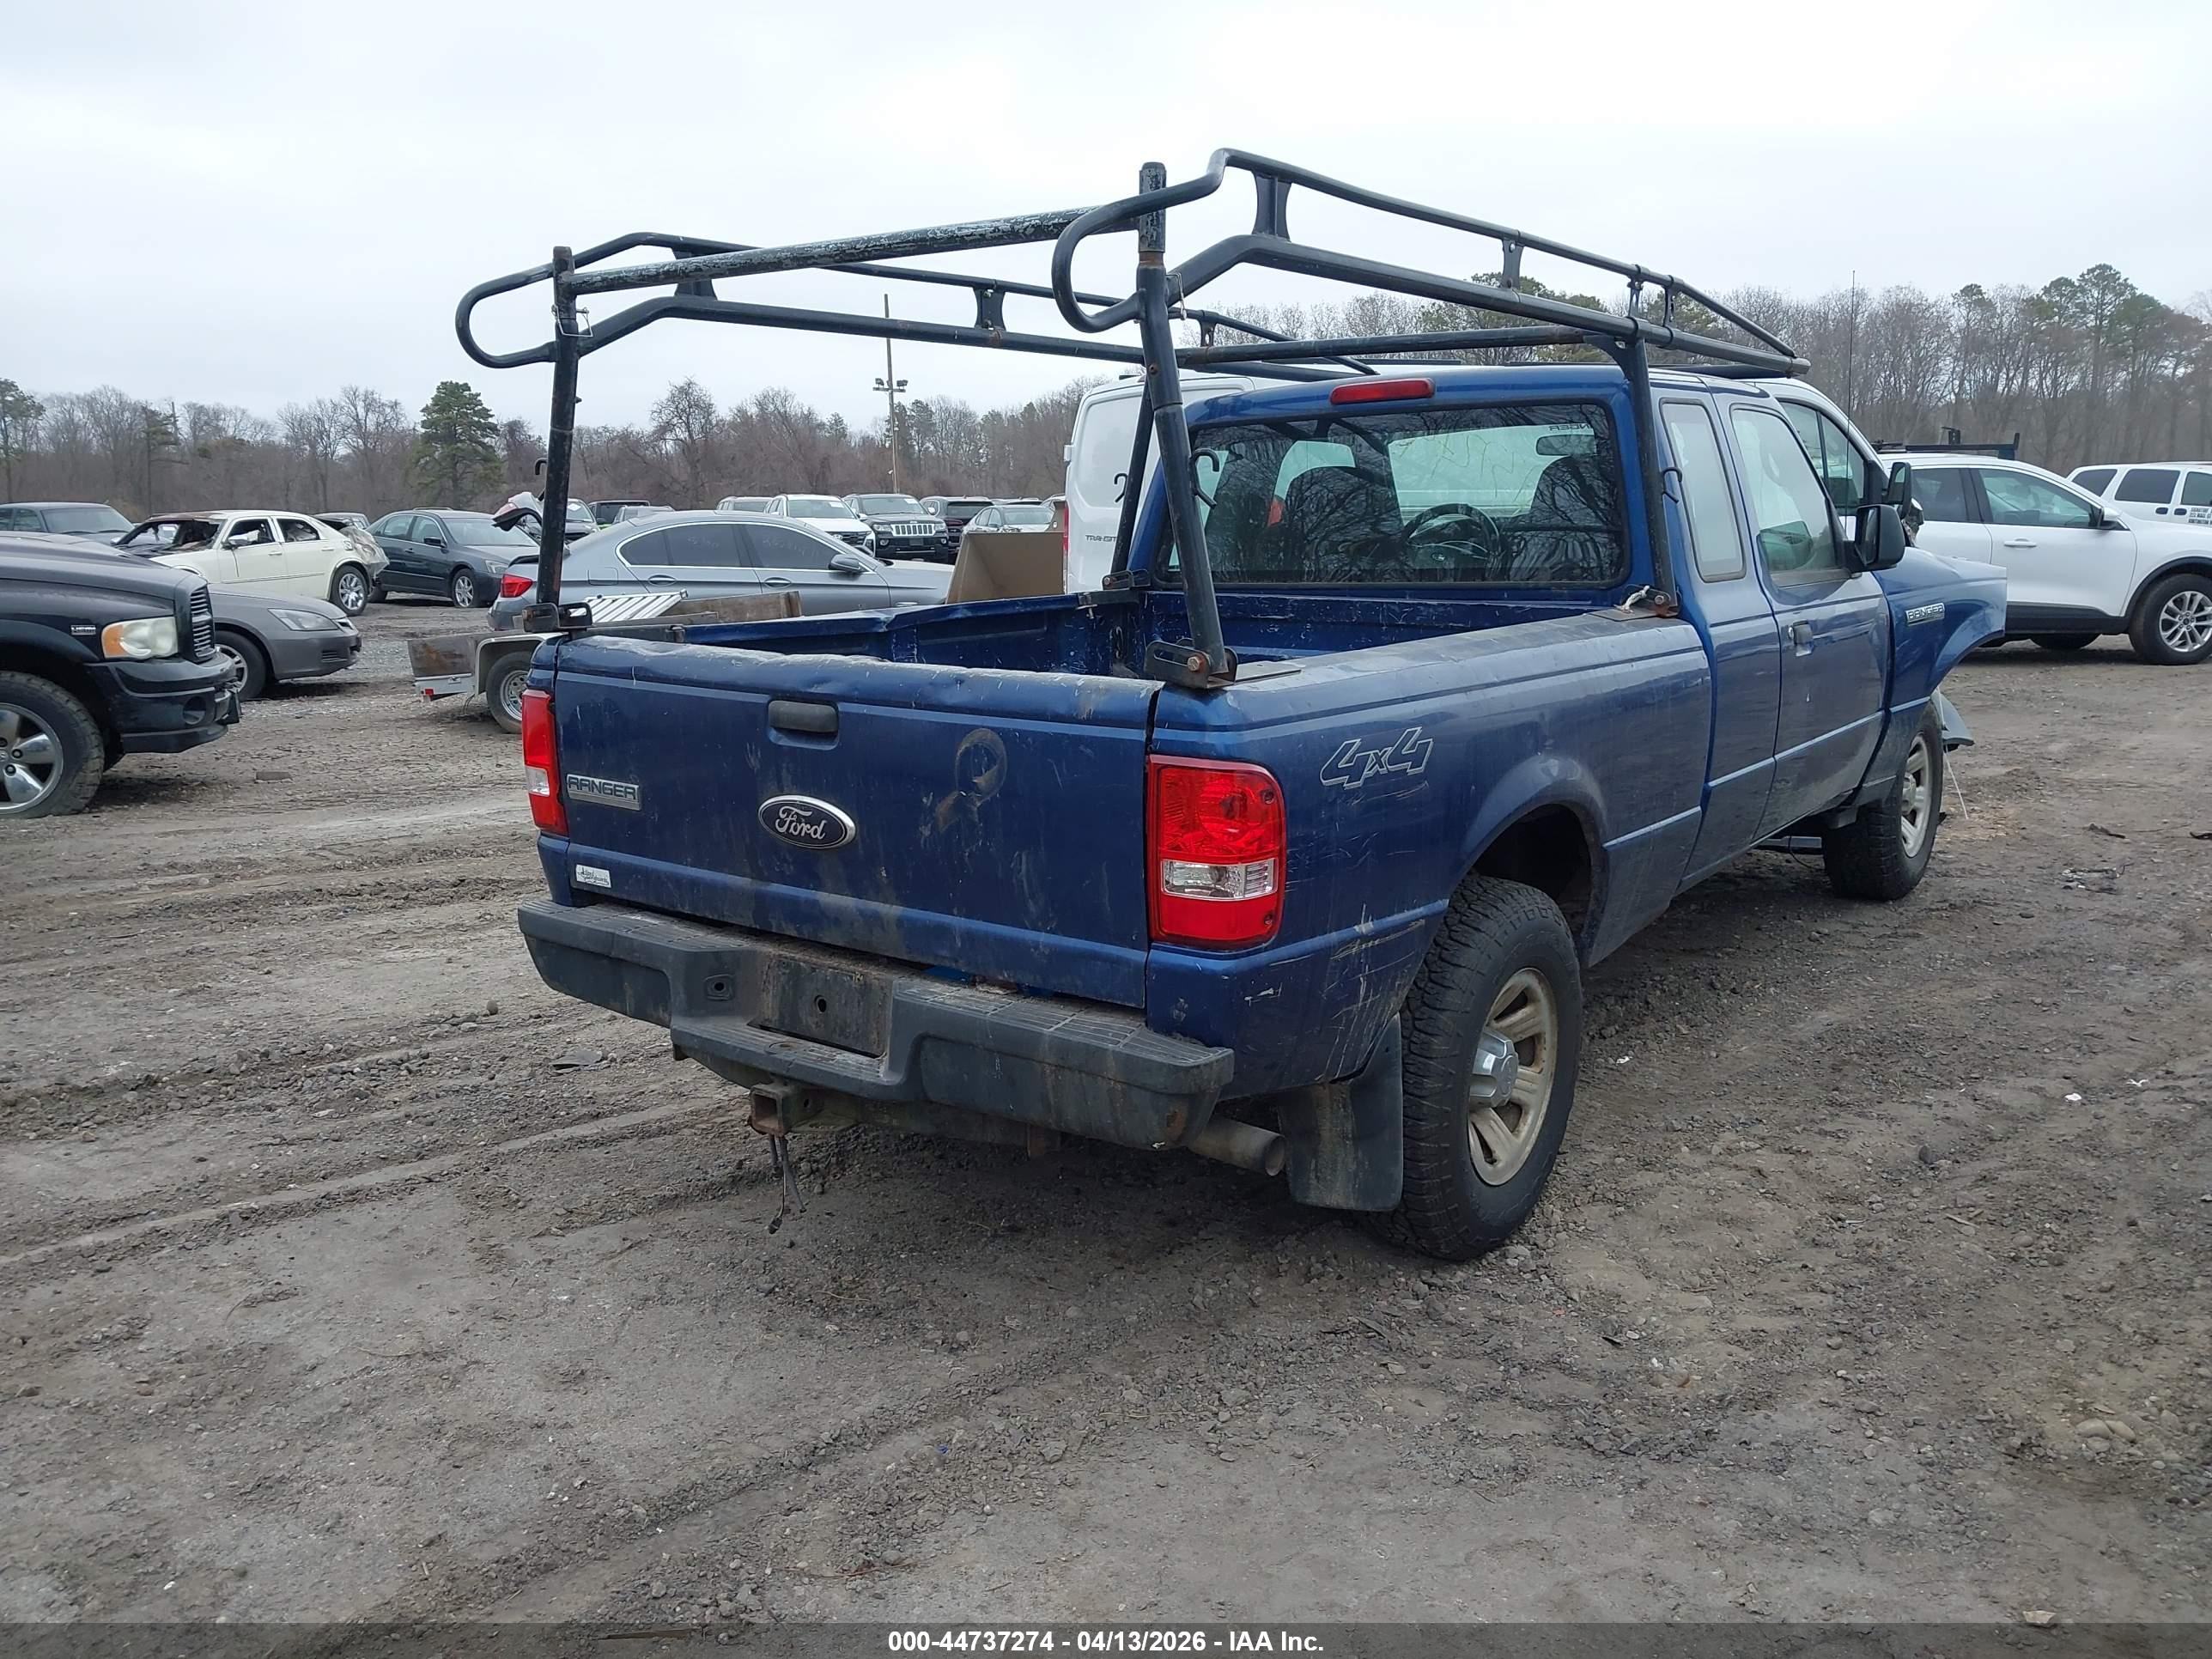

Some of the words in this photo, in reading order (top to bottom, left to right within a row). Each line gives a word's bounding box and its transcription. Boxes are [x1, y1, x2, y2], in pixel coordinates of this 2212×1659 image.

[1320, 726, 1434, 790] 4x4
[568, 775, 636, 799] RANGER
[775, 805, 827, 840] Ford
